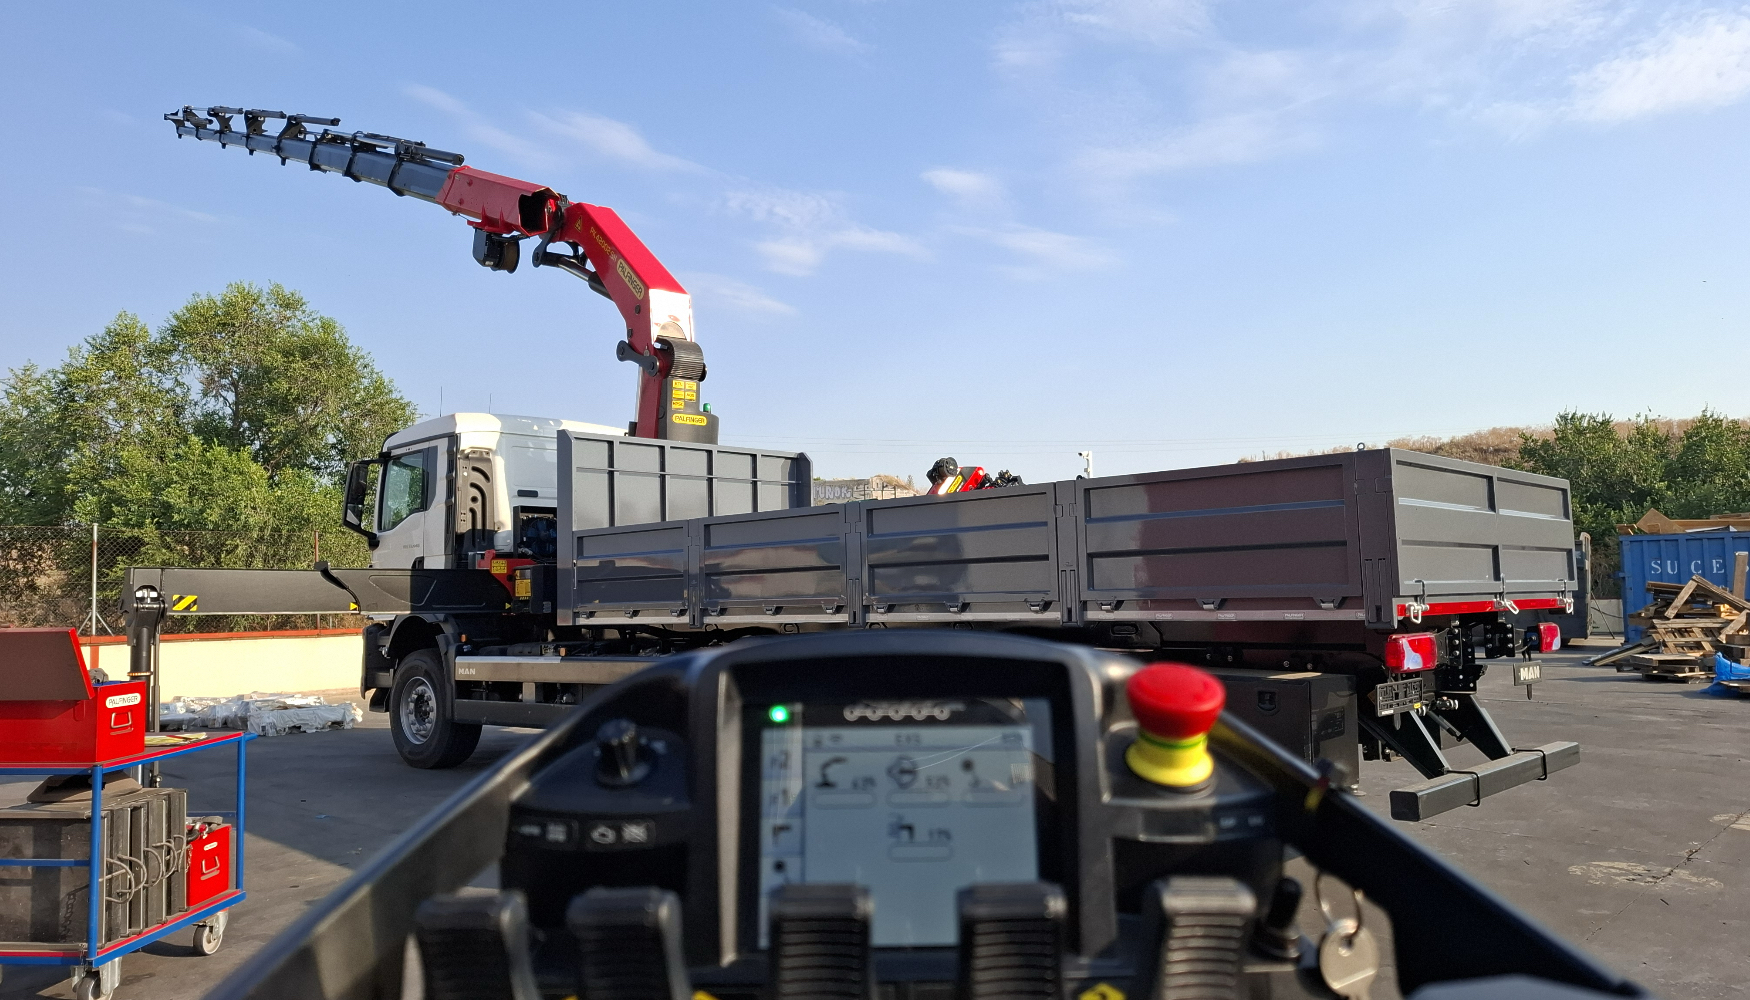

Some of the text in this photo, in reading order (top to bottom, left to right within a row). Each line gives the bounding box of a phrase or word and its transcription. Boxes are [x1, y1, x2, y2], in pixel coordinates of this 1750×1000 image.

[618, 261, 643, 298] PALFINGER
[674, 415, 706, 424] PALFINGER
[1651, 559, 1750, 574] SUCE
[458, 667, 476, 675] MAN
[1520, 665, 1540, 681] MAN
[108, 695, 139, 706] PALFINGER
